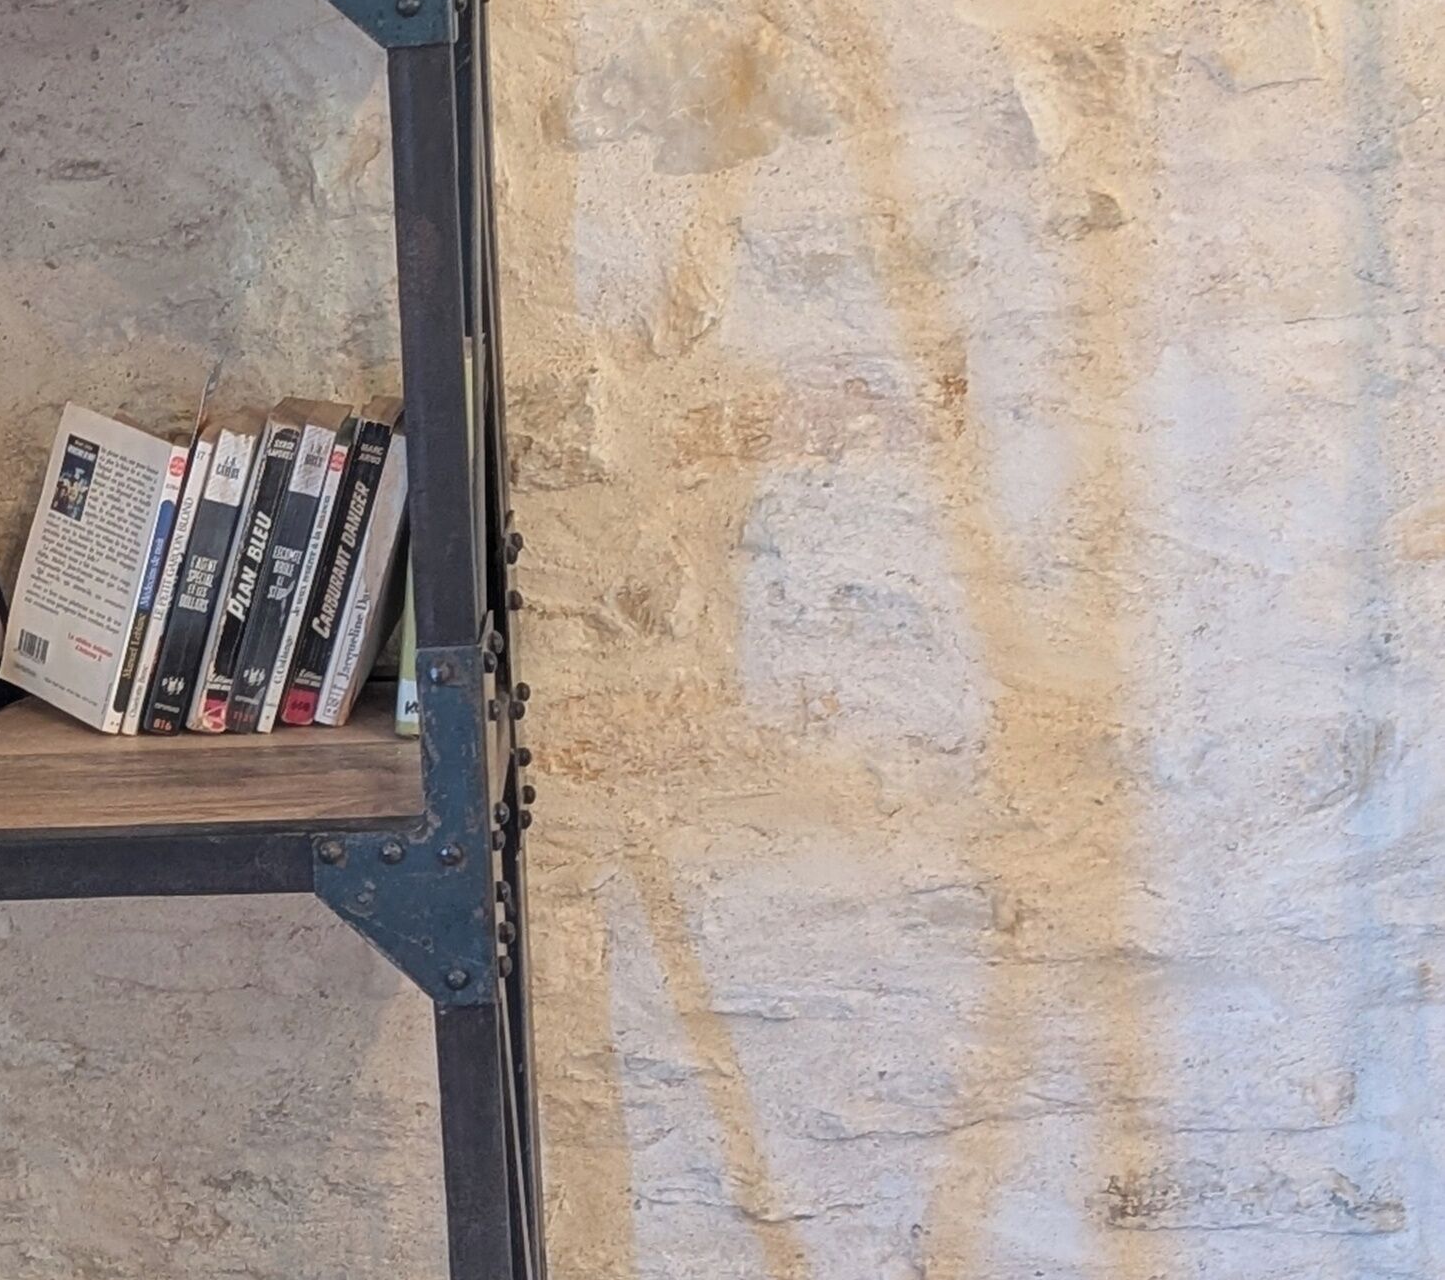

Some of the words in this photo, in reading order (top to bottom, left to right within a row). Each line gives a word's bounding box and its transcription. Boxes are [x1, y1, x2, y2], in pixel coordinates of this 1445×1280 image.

[176, 496, 194, 531] BLOND
[227, 565, 258, 622] PLAN
[245, 510, 272, 564] BLEU
[311, 545, 353, 639] CARBURANT
[339, 481, 371, 547] DANGER
[153, 606, 165, 621] LE
[157, 578, 172, 606] PETIT
[334, 612, 370, 681] Jacqueline
